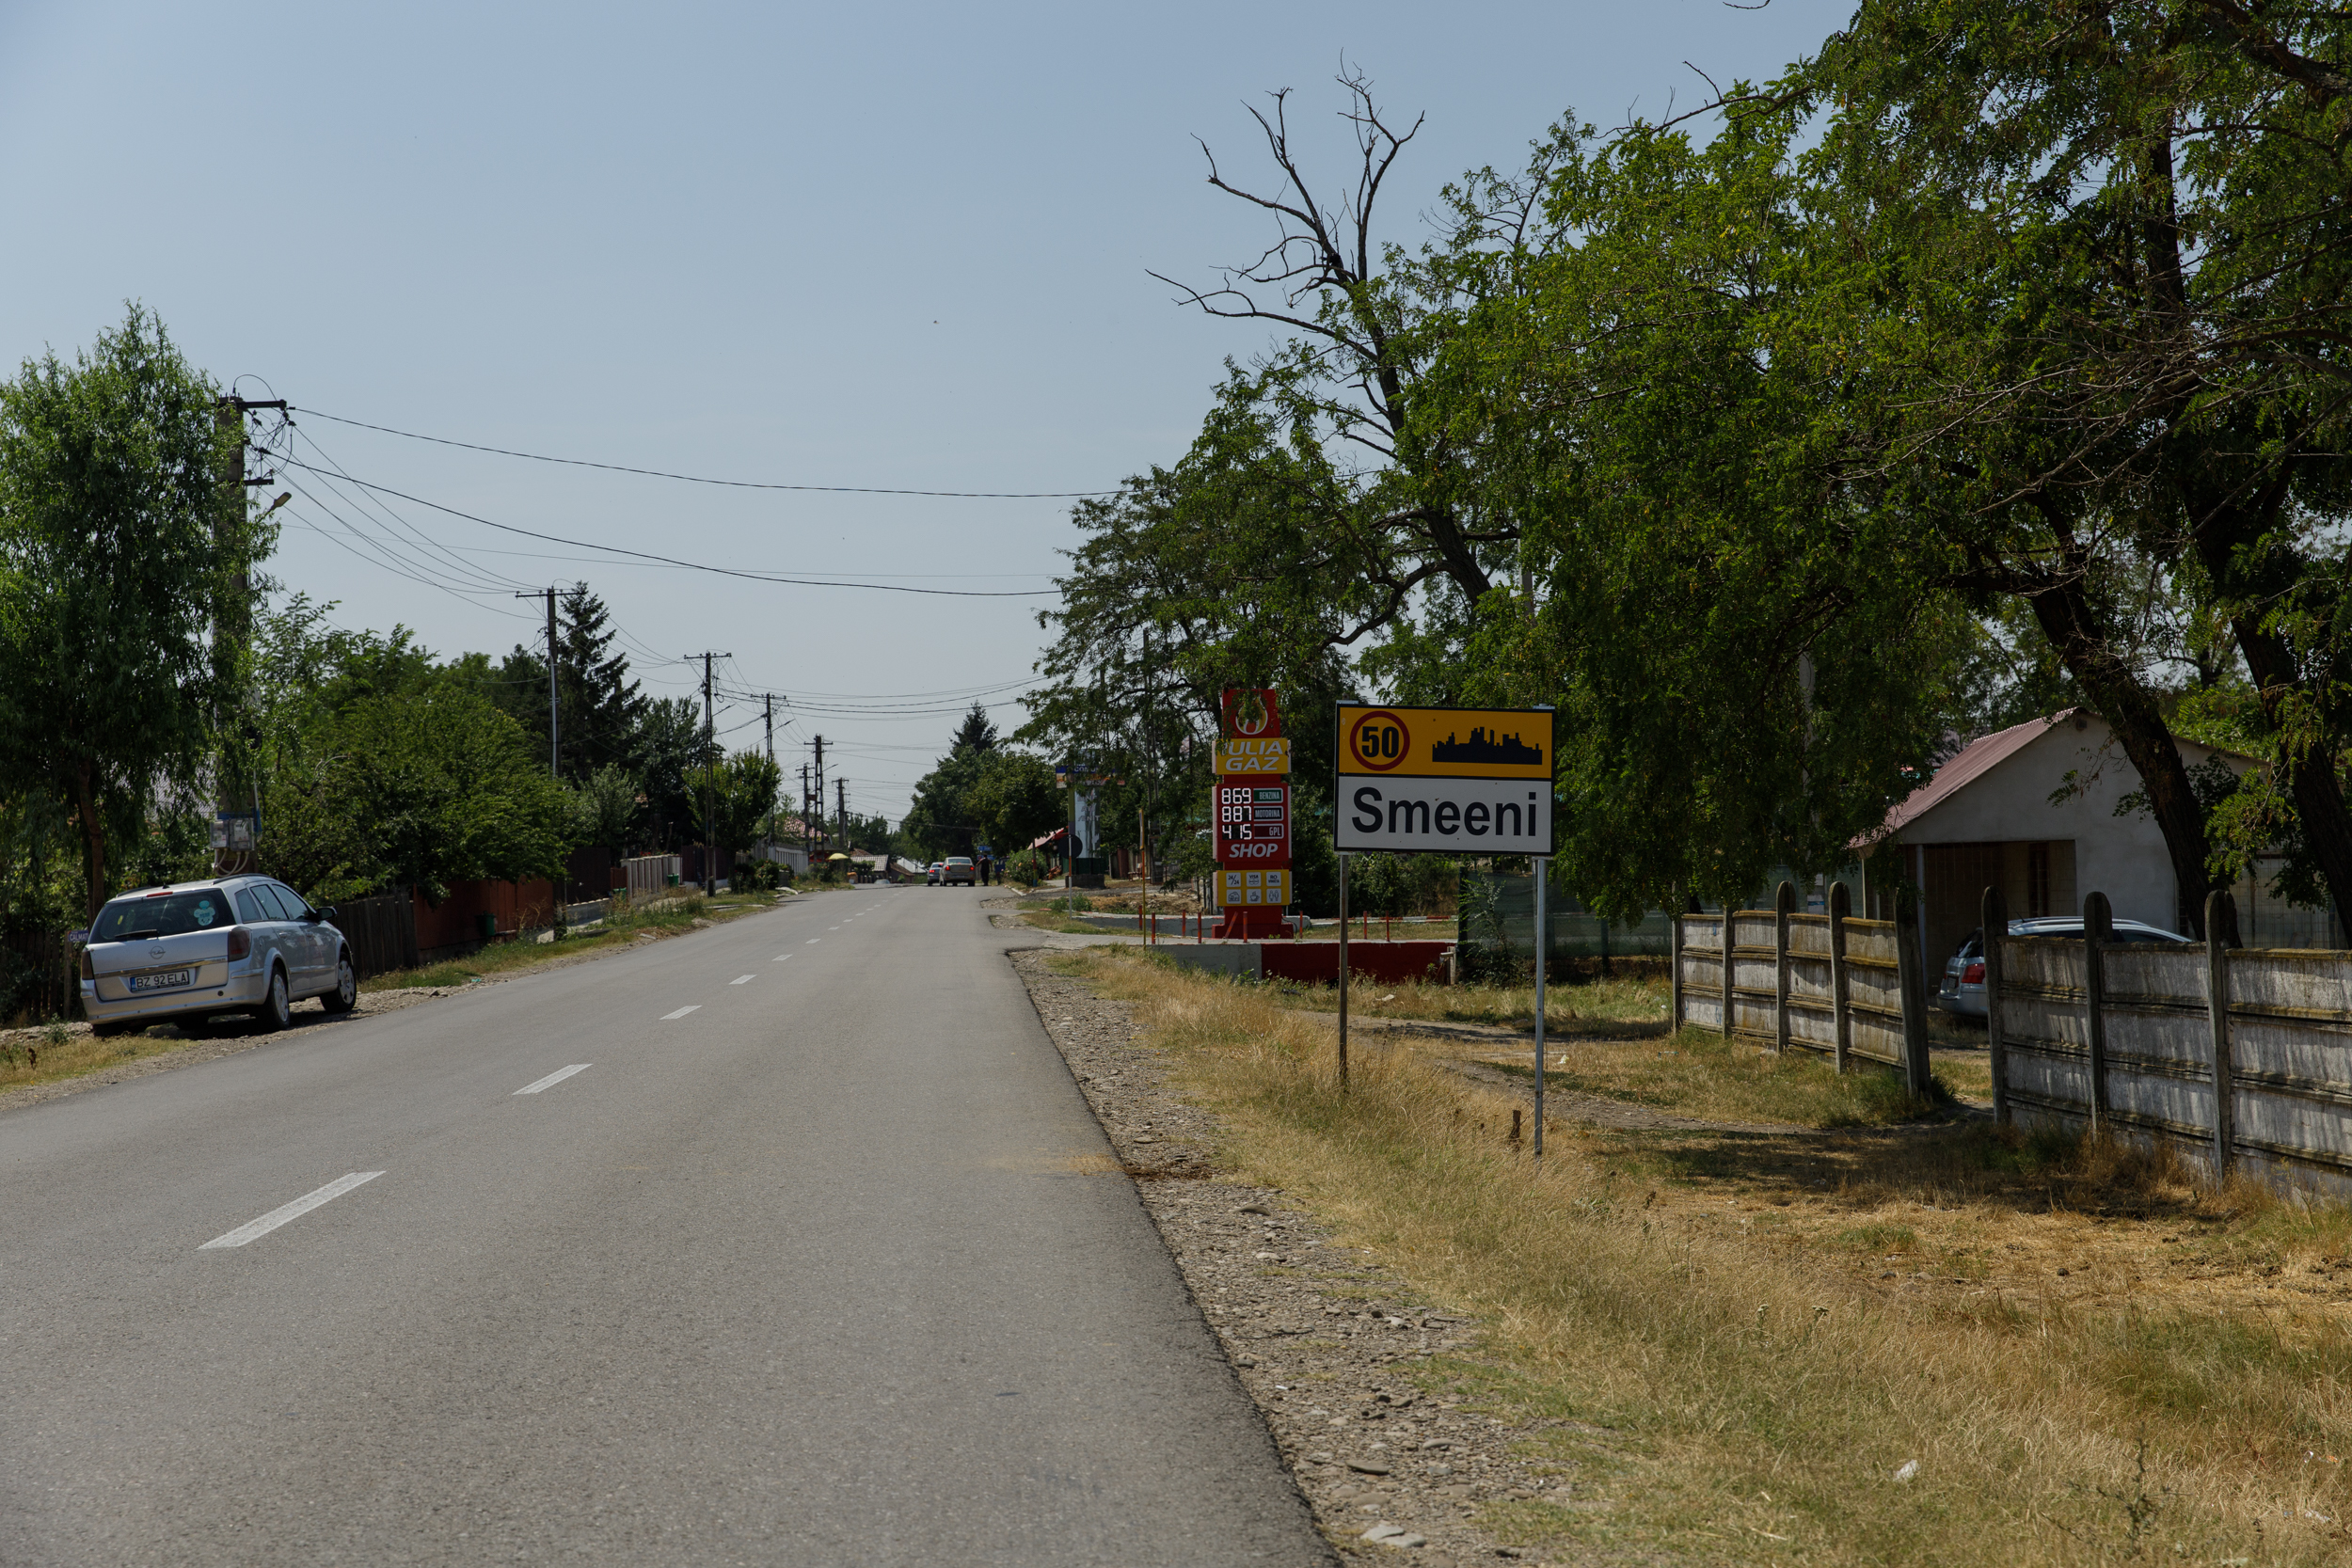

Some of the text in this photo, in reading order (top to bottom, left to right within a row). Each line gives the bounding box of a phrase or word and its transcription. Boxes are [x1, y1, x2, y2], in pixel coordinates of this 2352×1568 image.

[1361, 726, 1399, 758] 50
[1226, 757, 1279, 771] GAZ
[1222, 788, 1251, 804] 869
[1222, 805, 1251, 822] 887
[1352, 786, 1536, 836] Smeeni
[1222, 824, 1252, 840] 415
[1269, 827, 1280, 836] GPL
[1229, 844, 1279, 858] SHOP
[136, 973, 187, 988] BZ 92 ELA
